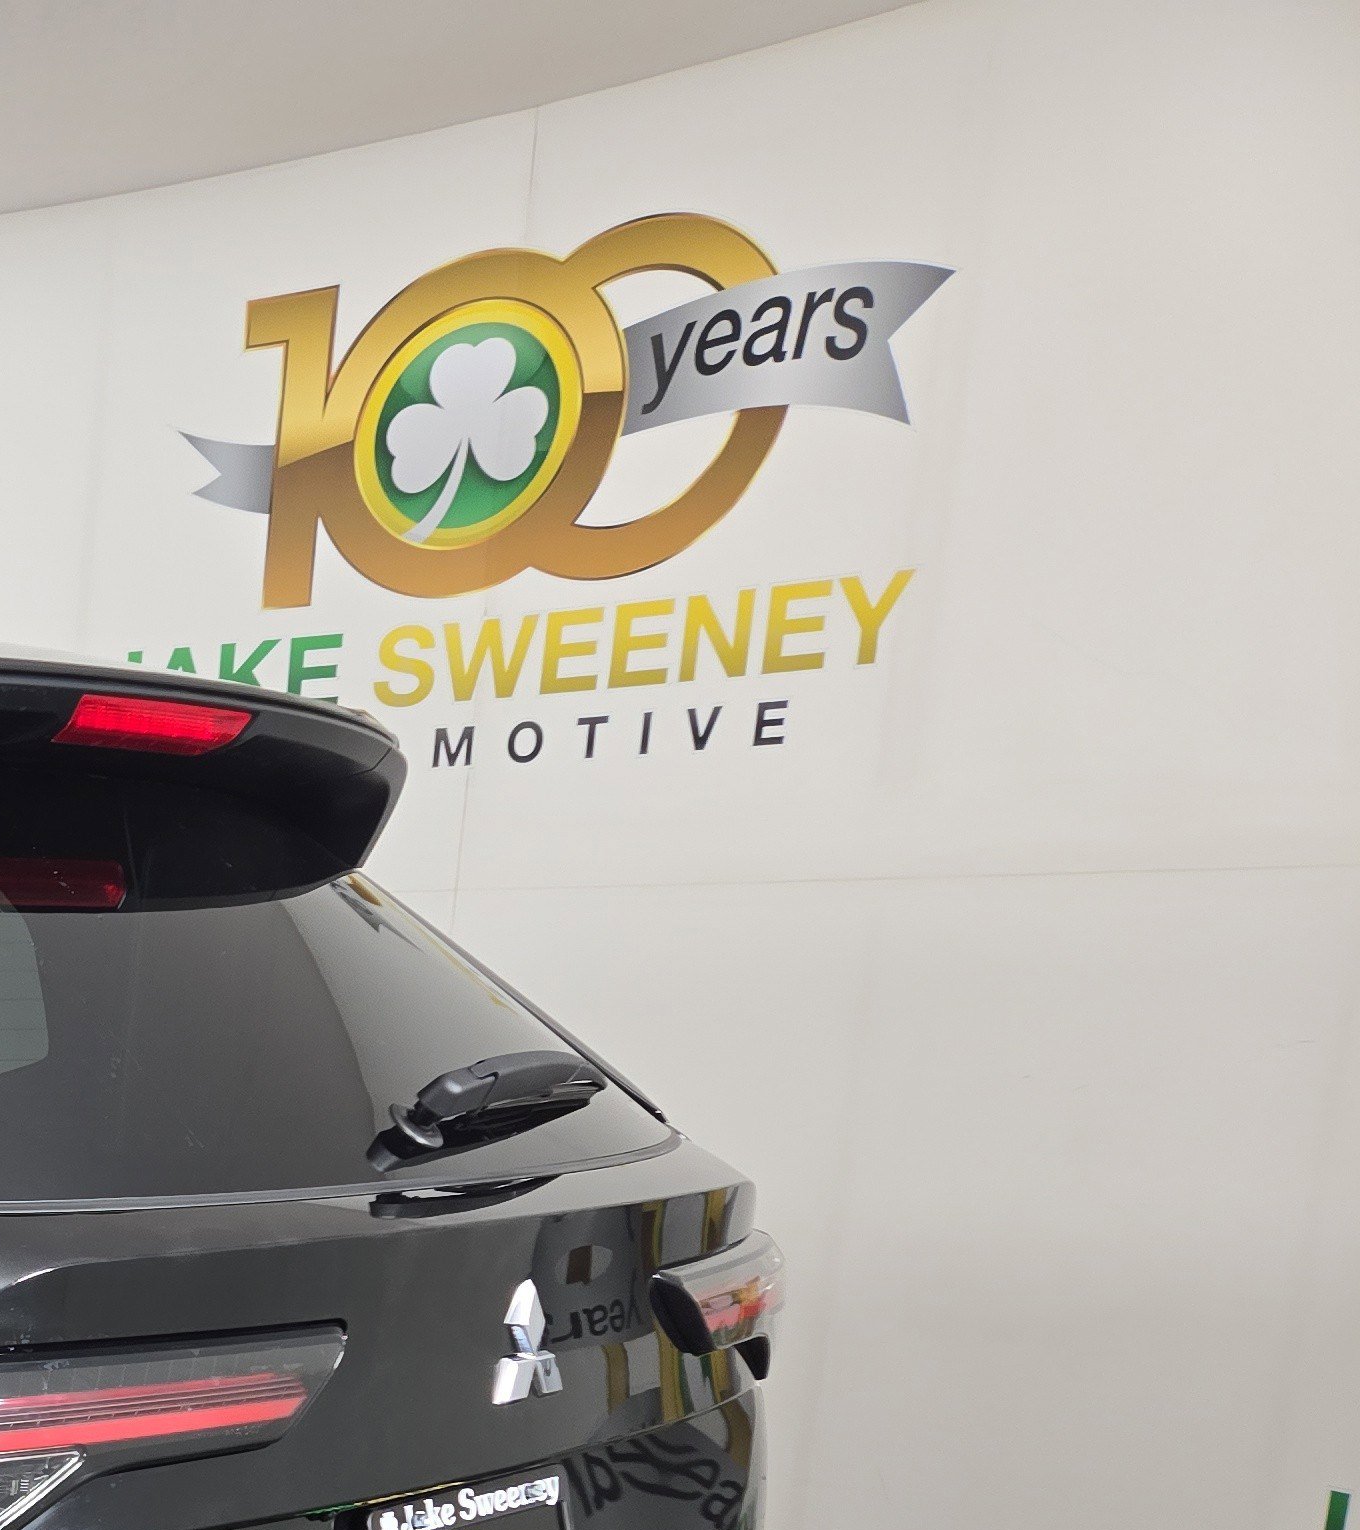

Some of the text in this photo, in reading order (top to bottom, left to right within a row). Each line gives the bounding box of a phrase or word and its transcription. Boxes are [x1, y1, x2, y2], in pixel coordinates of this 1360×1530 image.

[245, 212, 875, 610] 100 years
[127, 569, 917, 708] KE SWEENEY
